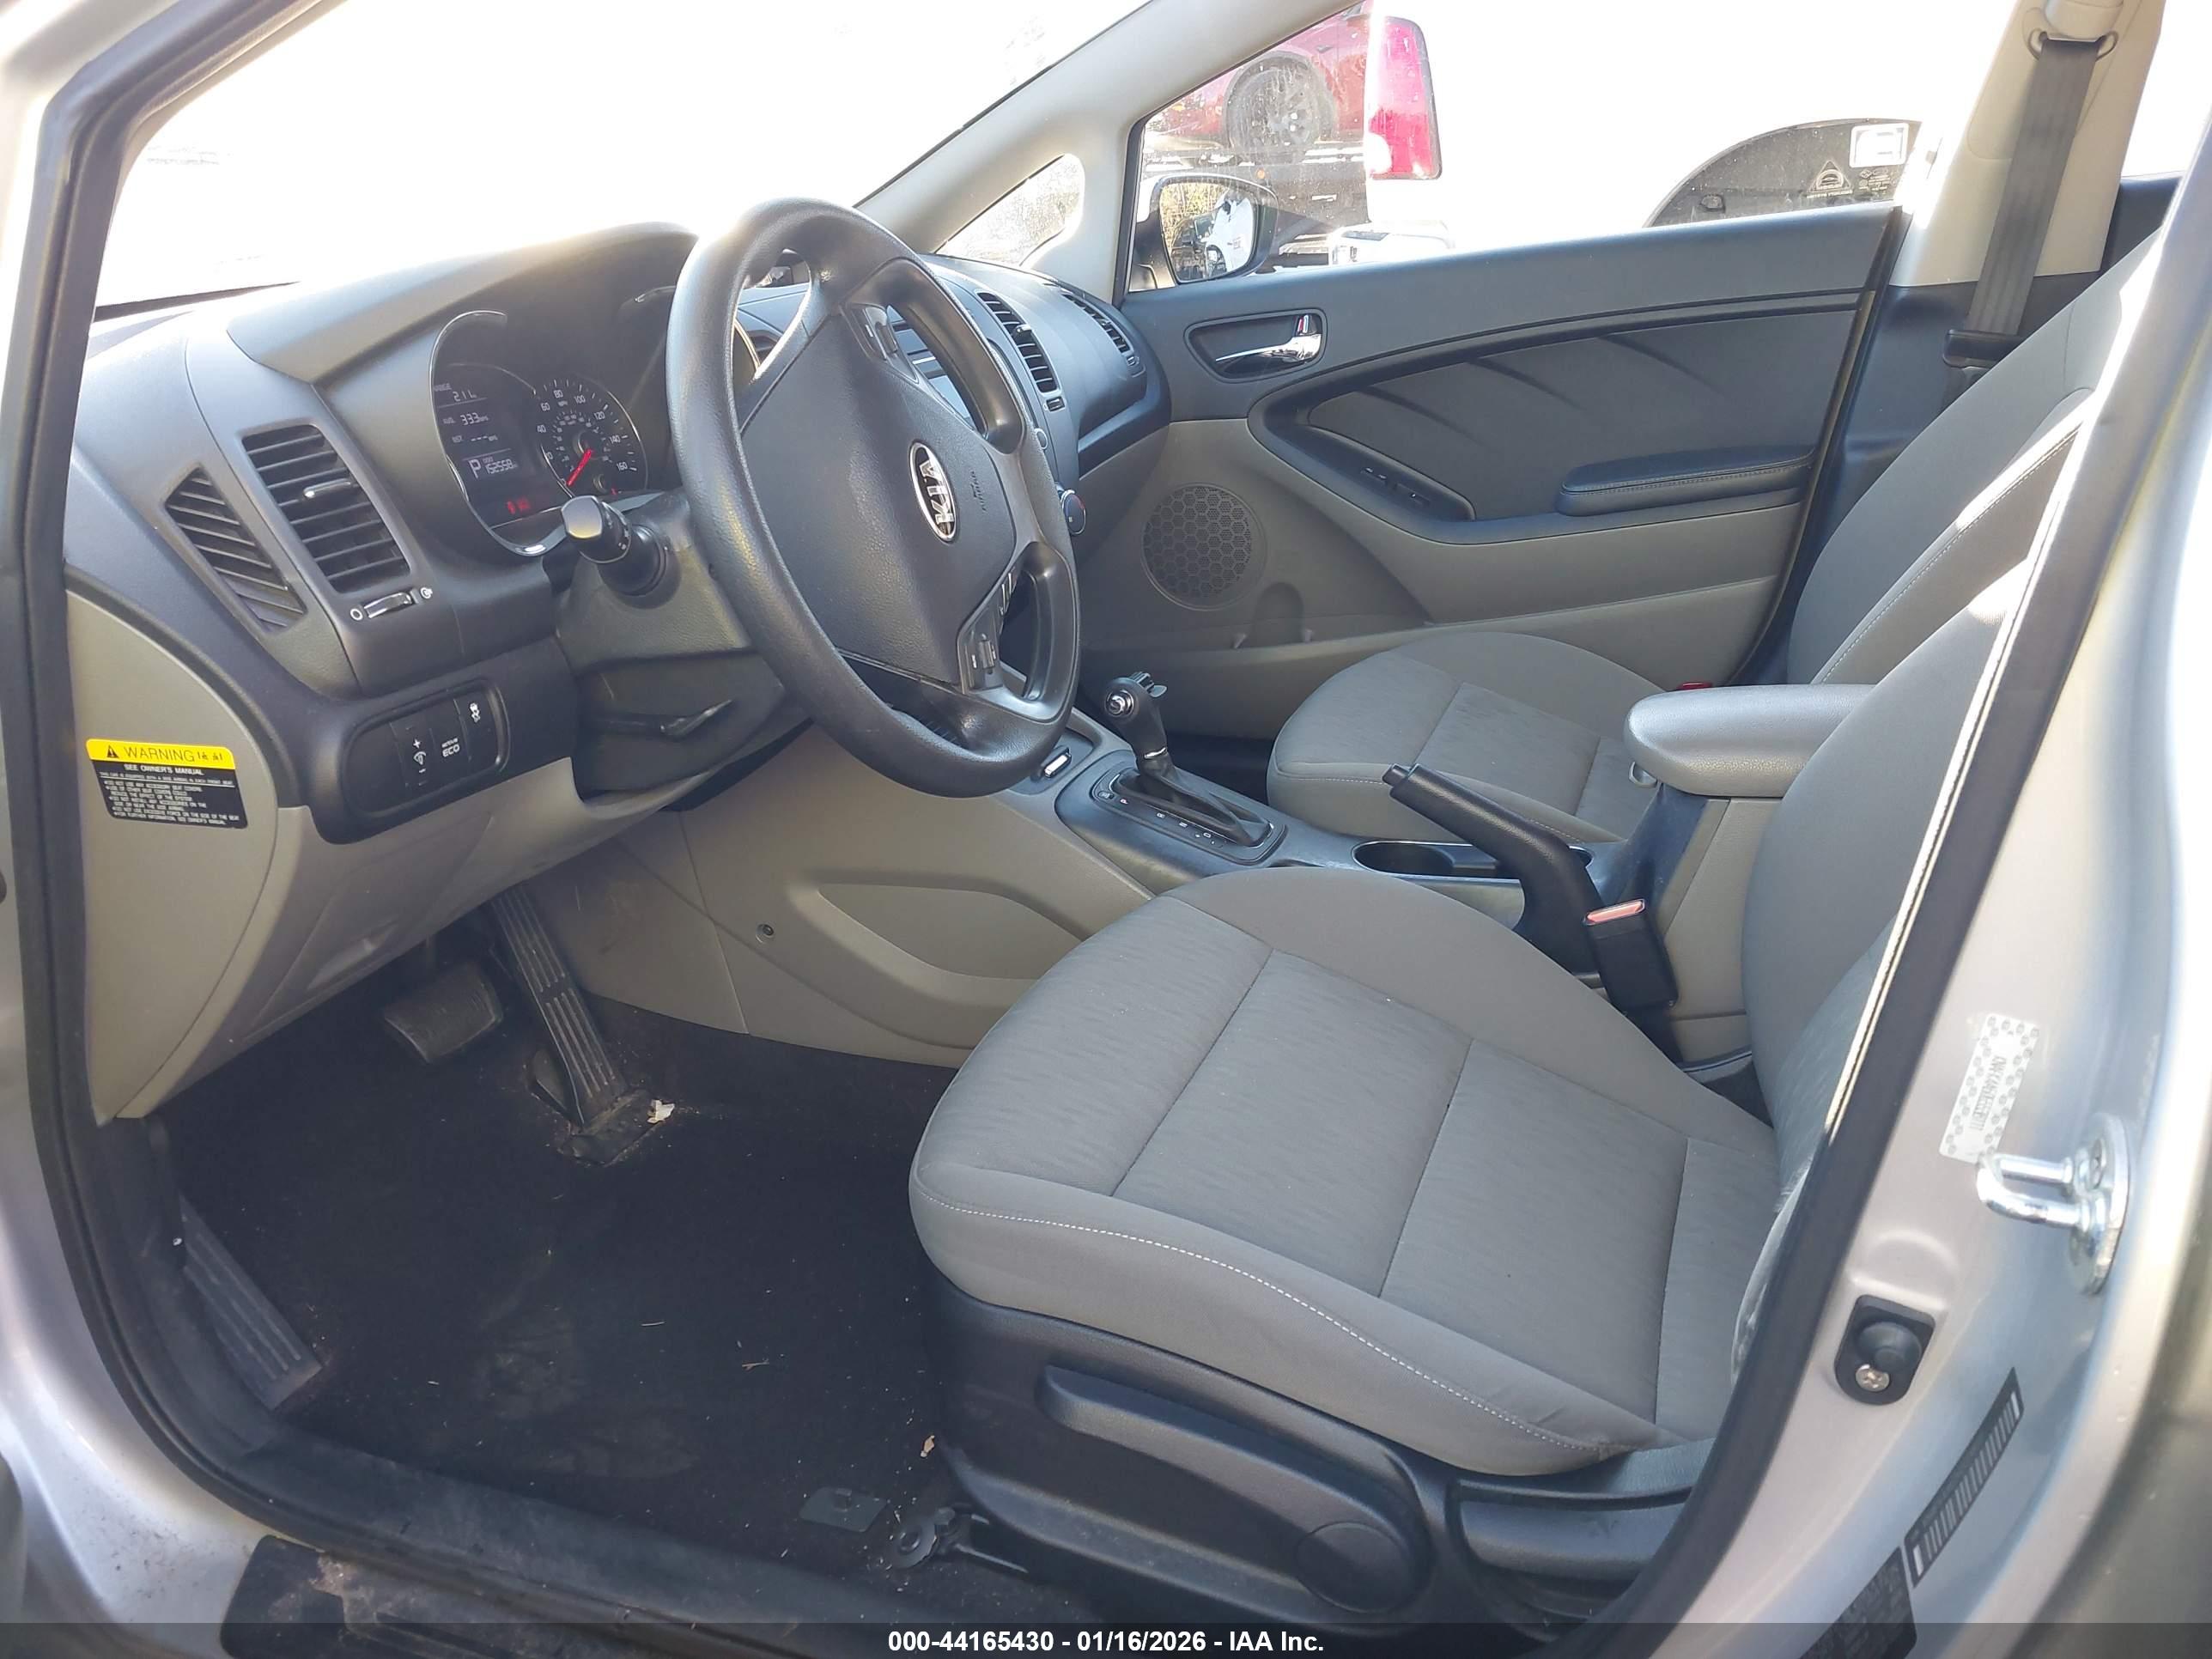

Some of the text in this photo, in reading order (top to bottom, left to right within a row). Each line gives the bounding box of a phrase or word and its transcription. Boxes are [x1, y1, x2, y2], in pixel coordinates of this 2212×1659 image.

[553, 389, 563, 398] 80
[574, 394, 586, 404] 100
[459, 412, 480, 426] 333
[593, 410, 605, 420] 120
[609, 434, 621, 445] 140
[468, 459, 482, 479] P
[919, 459, 956, 526] KIA
[124, 745, 195, 763] WARNING
[442, 744, 460, 757] ECO
